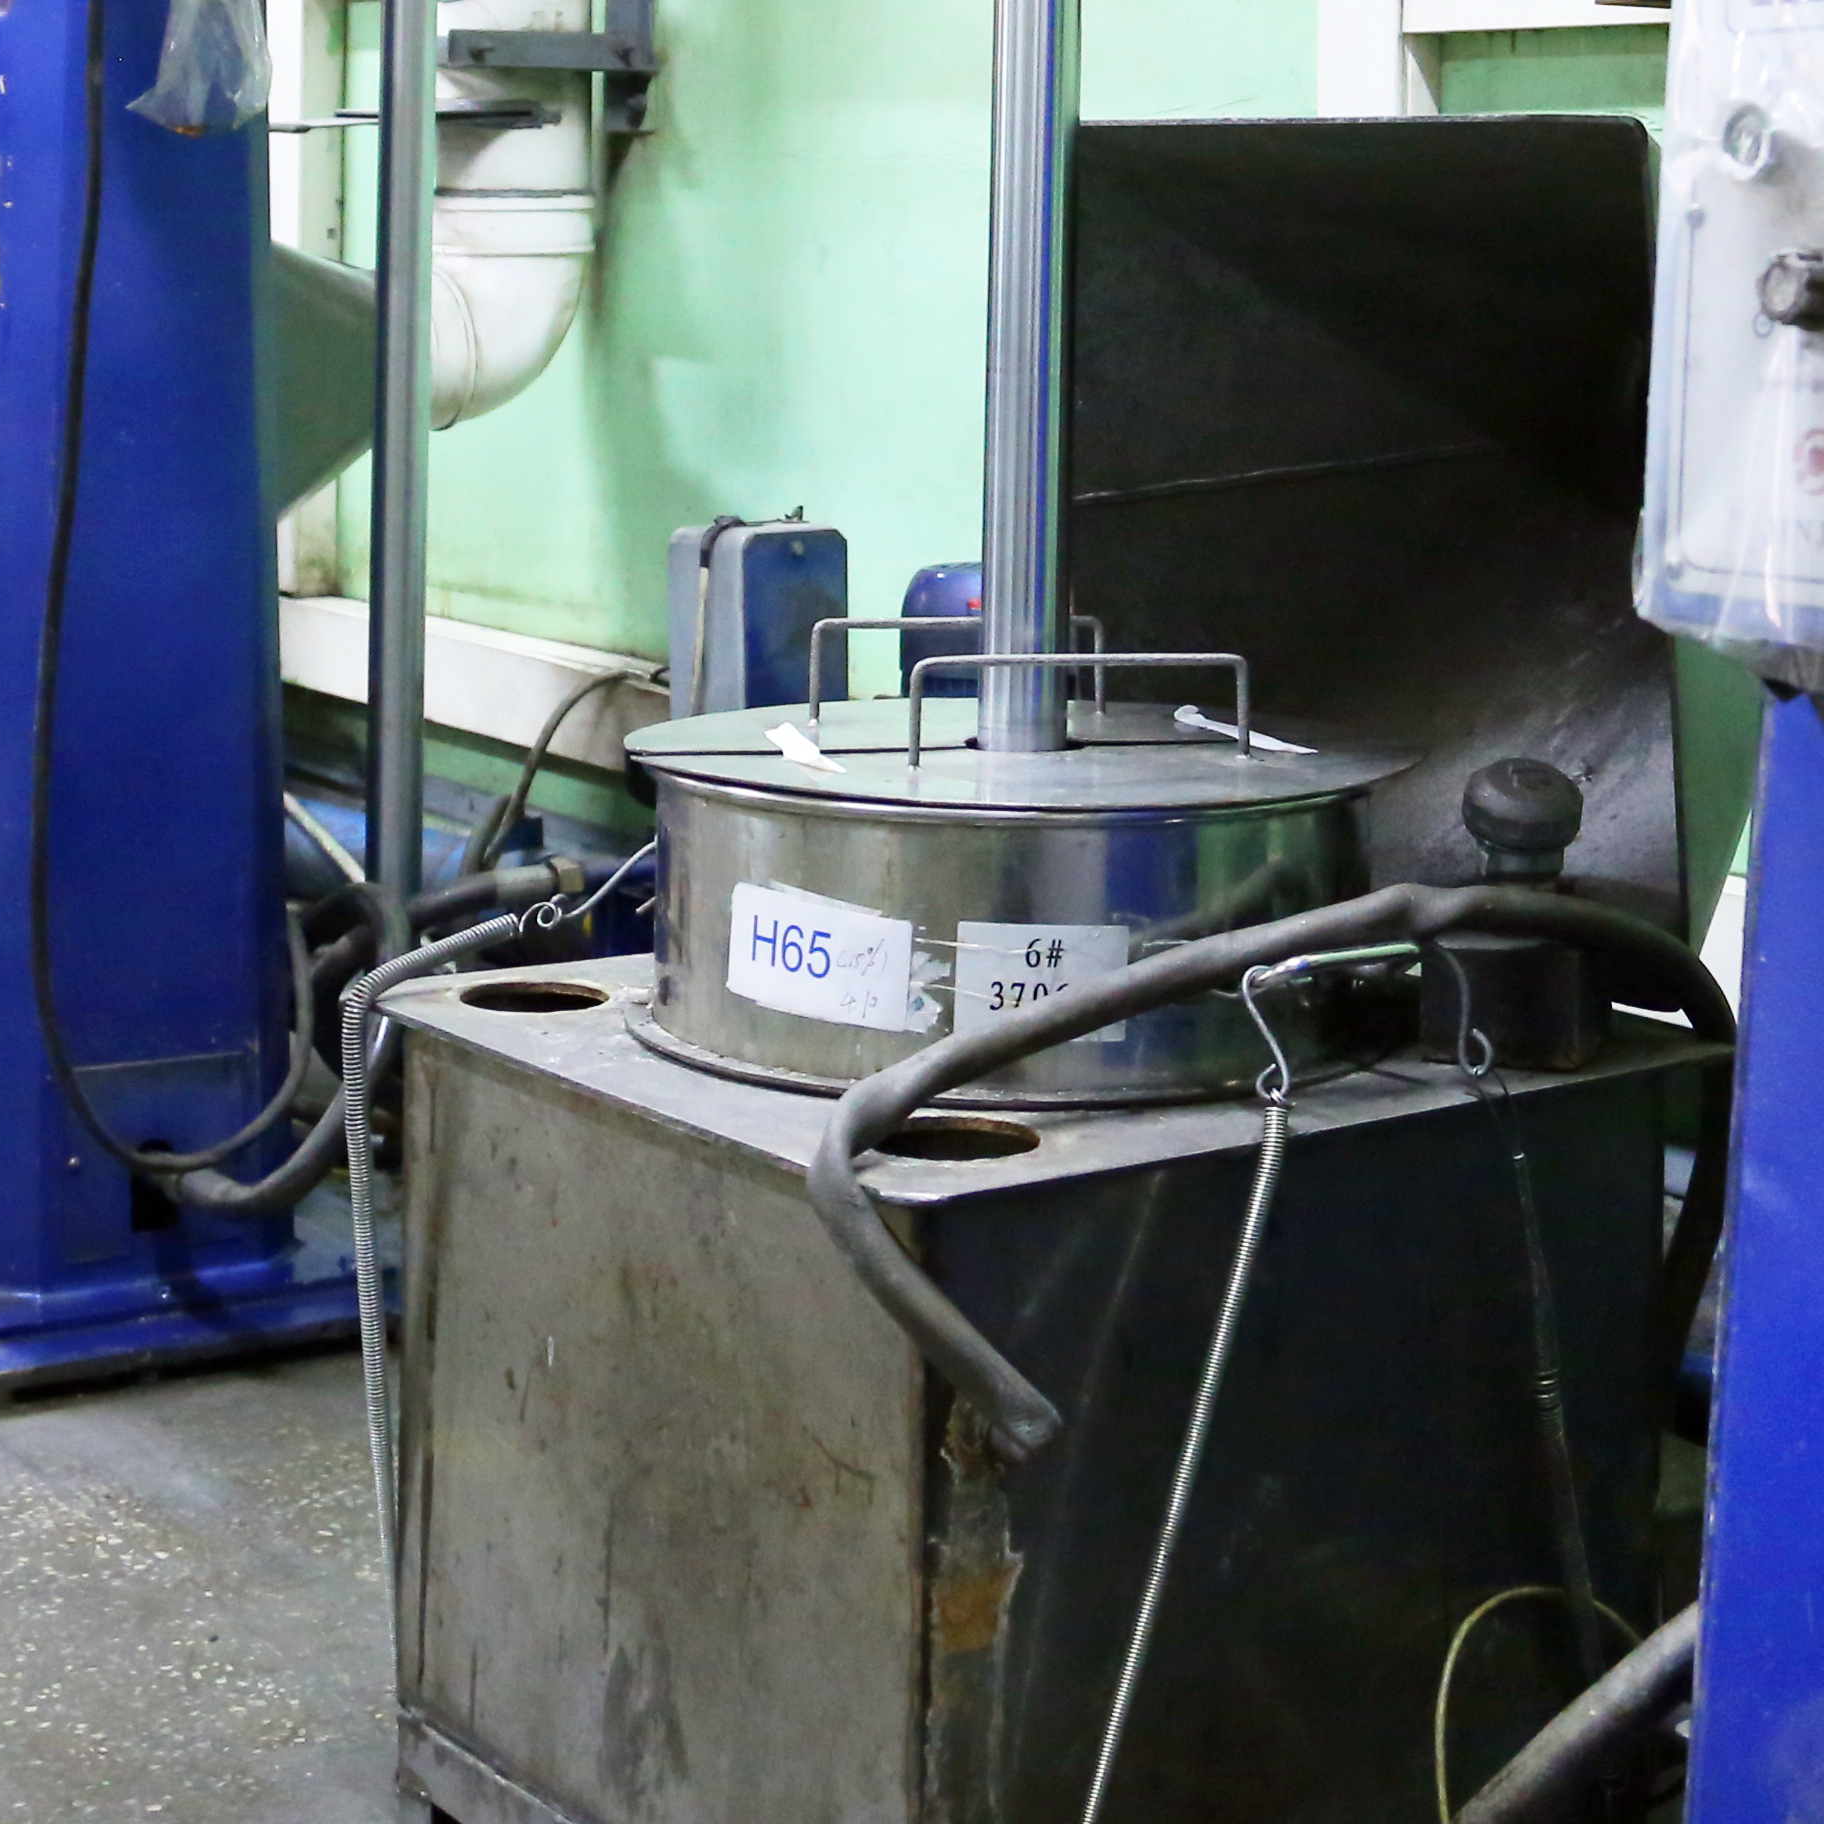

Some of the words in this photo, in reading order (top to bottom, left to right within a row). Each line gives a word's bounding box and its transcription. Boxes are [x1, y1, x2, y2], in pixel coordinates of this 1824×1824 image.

[751, 915, 832, 979] H65
[1025, 938, 1064, 968] 6#
[989, 981, 1069, 1011] 370
